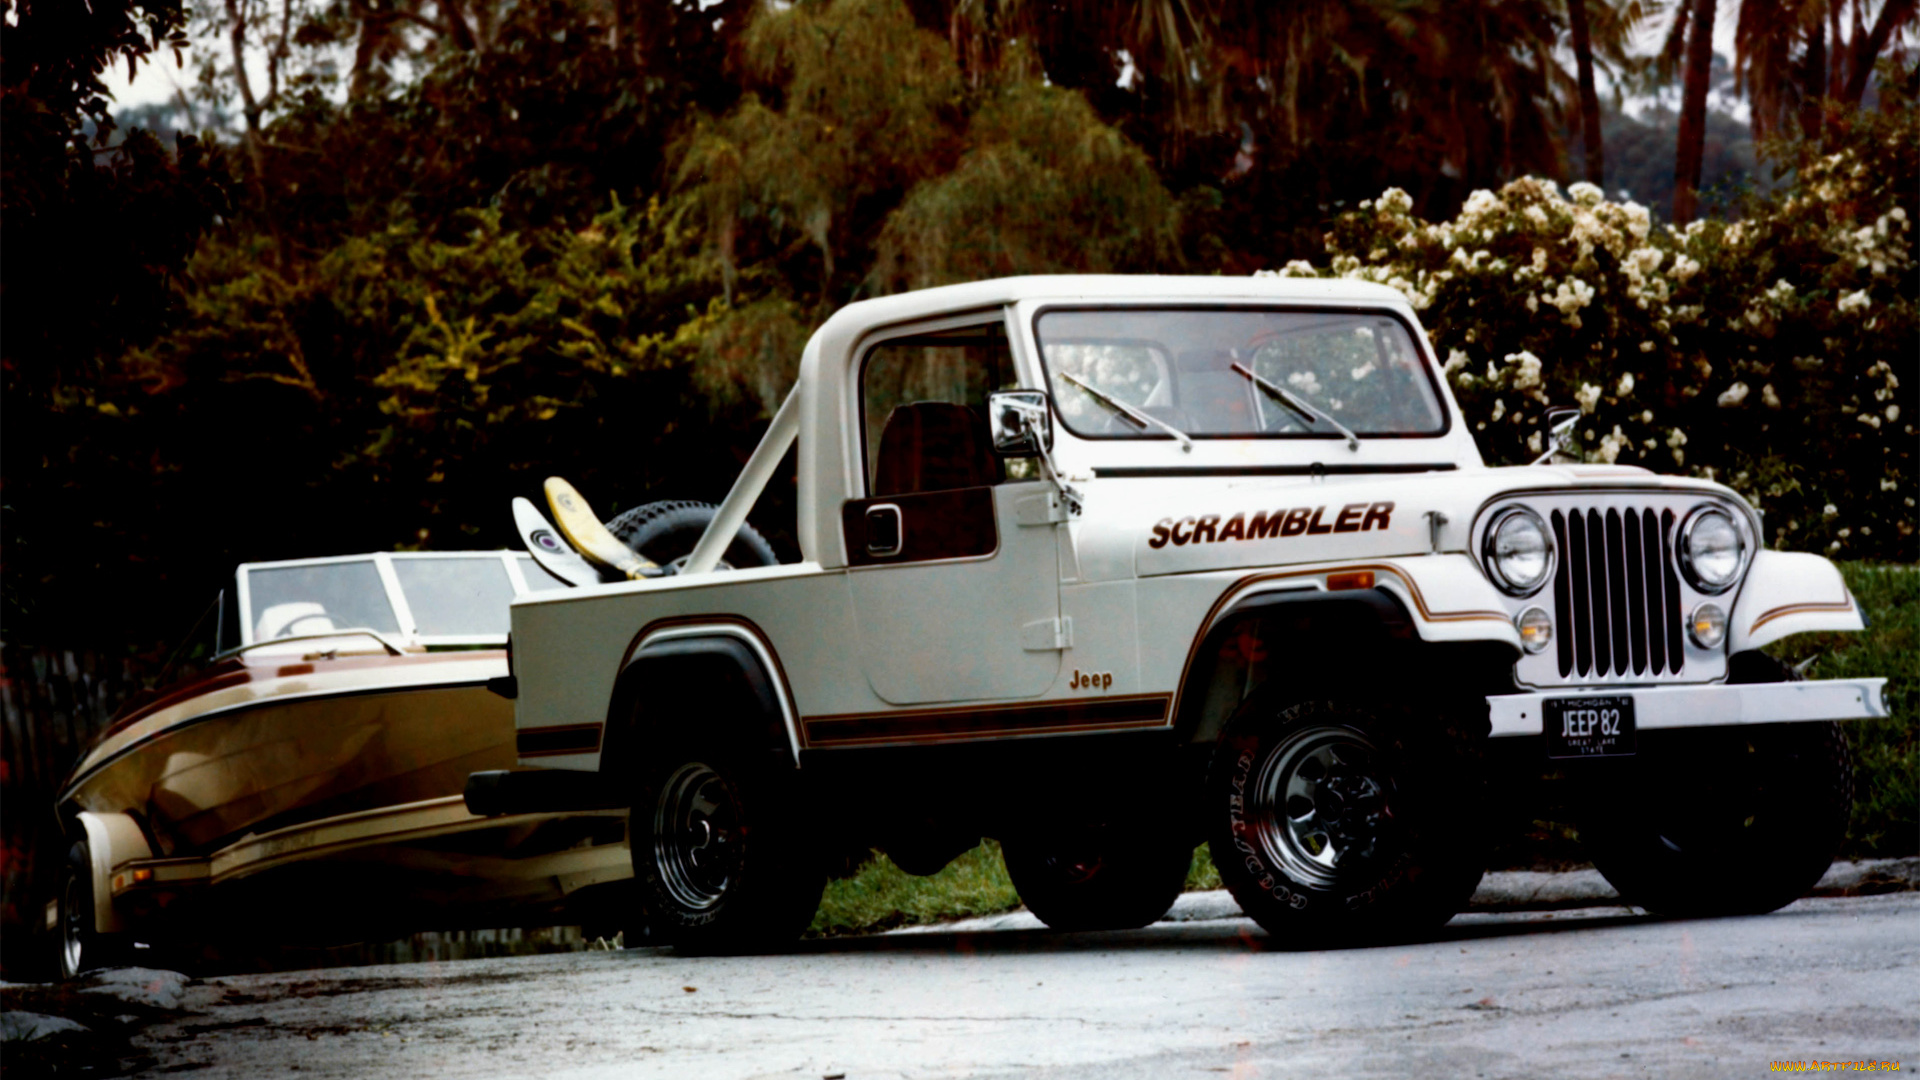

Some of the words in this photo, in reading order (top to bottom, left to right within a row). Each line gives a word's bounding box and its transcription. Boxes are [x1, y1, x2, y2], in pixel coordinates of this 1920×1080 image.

[1149, 501, 1395, 550] SCRAMBLER
[1069, 669, 1112, 691] Jeep
[1568, 699, 1611, 707] MICHIGAN
[1562, 709, 1598, 737] JEEP
[1600, 708, 1620, 735] 82
